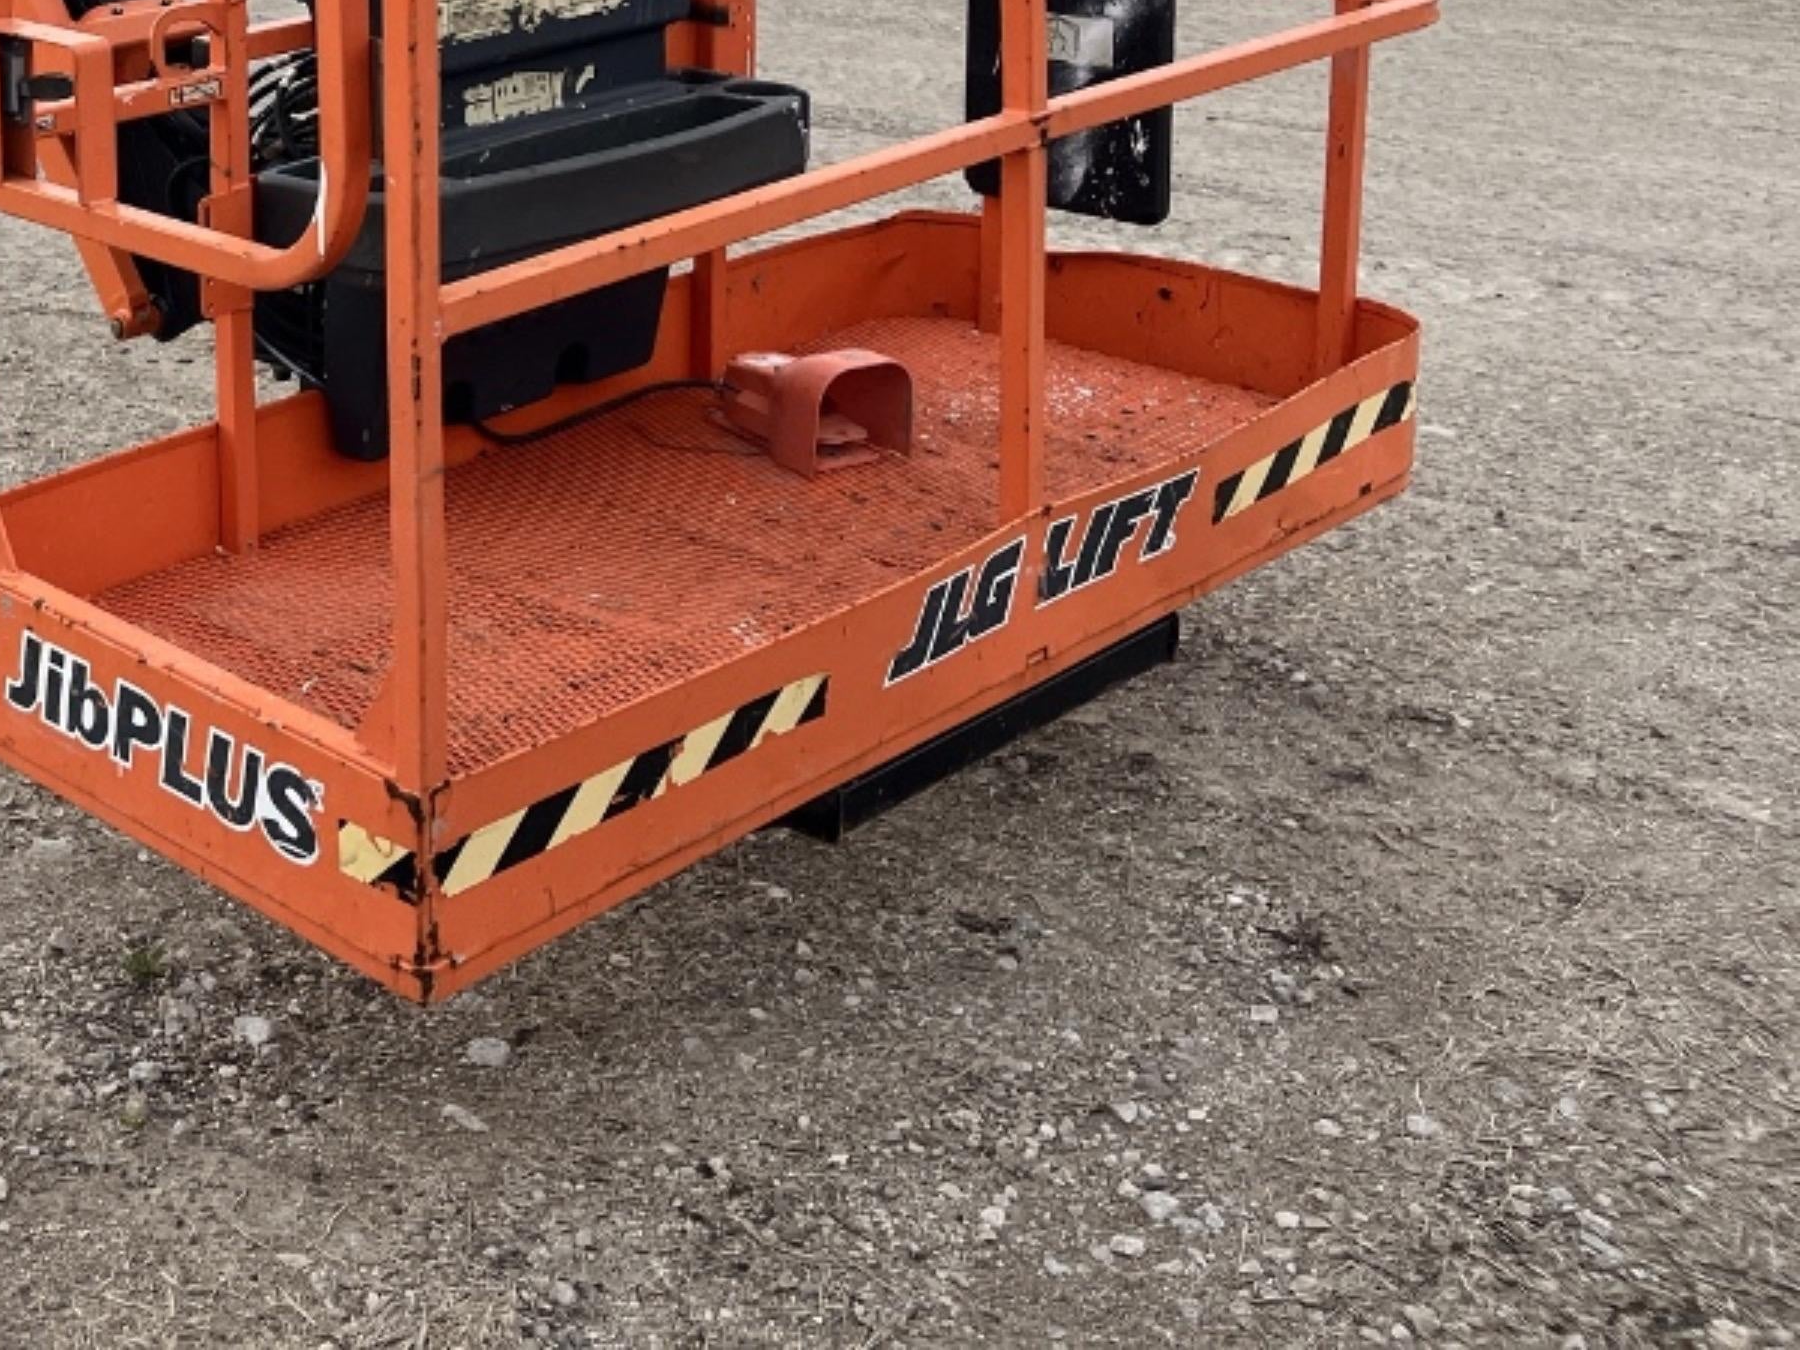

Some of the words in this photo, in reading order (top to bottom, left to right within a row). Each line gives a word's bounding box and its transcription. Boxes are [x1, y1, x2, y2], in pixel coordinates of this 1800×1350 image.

[883, 534, 1027, 689] JLG
[1035, 466, 1200, 611] LIFT
[5, 628, 320, 867] JibPLUS
